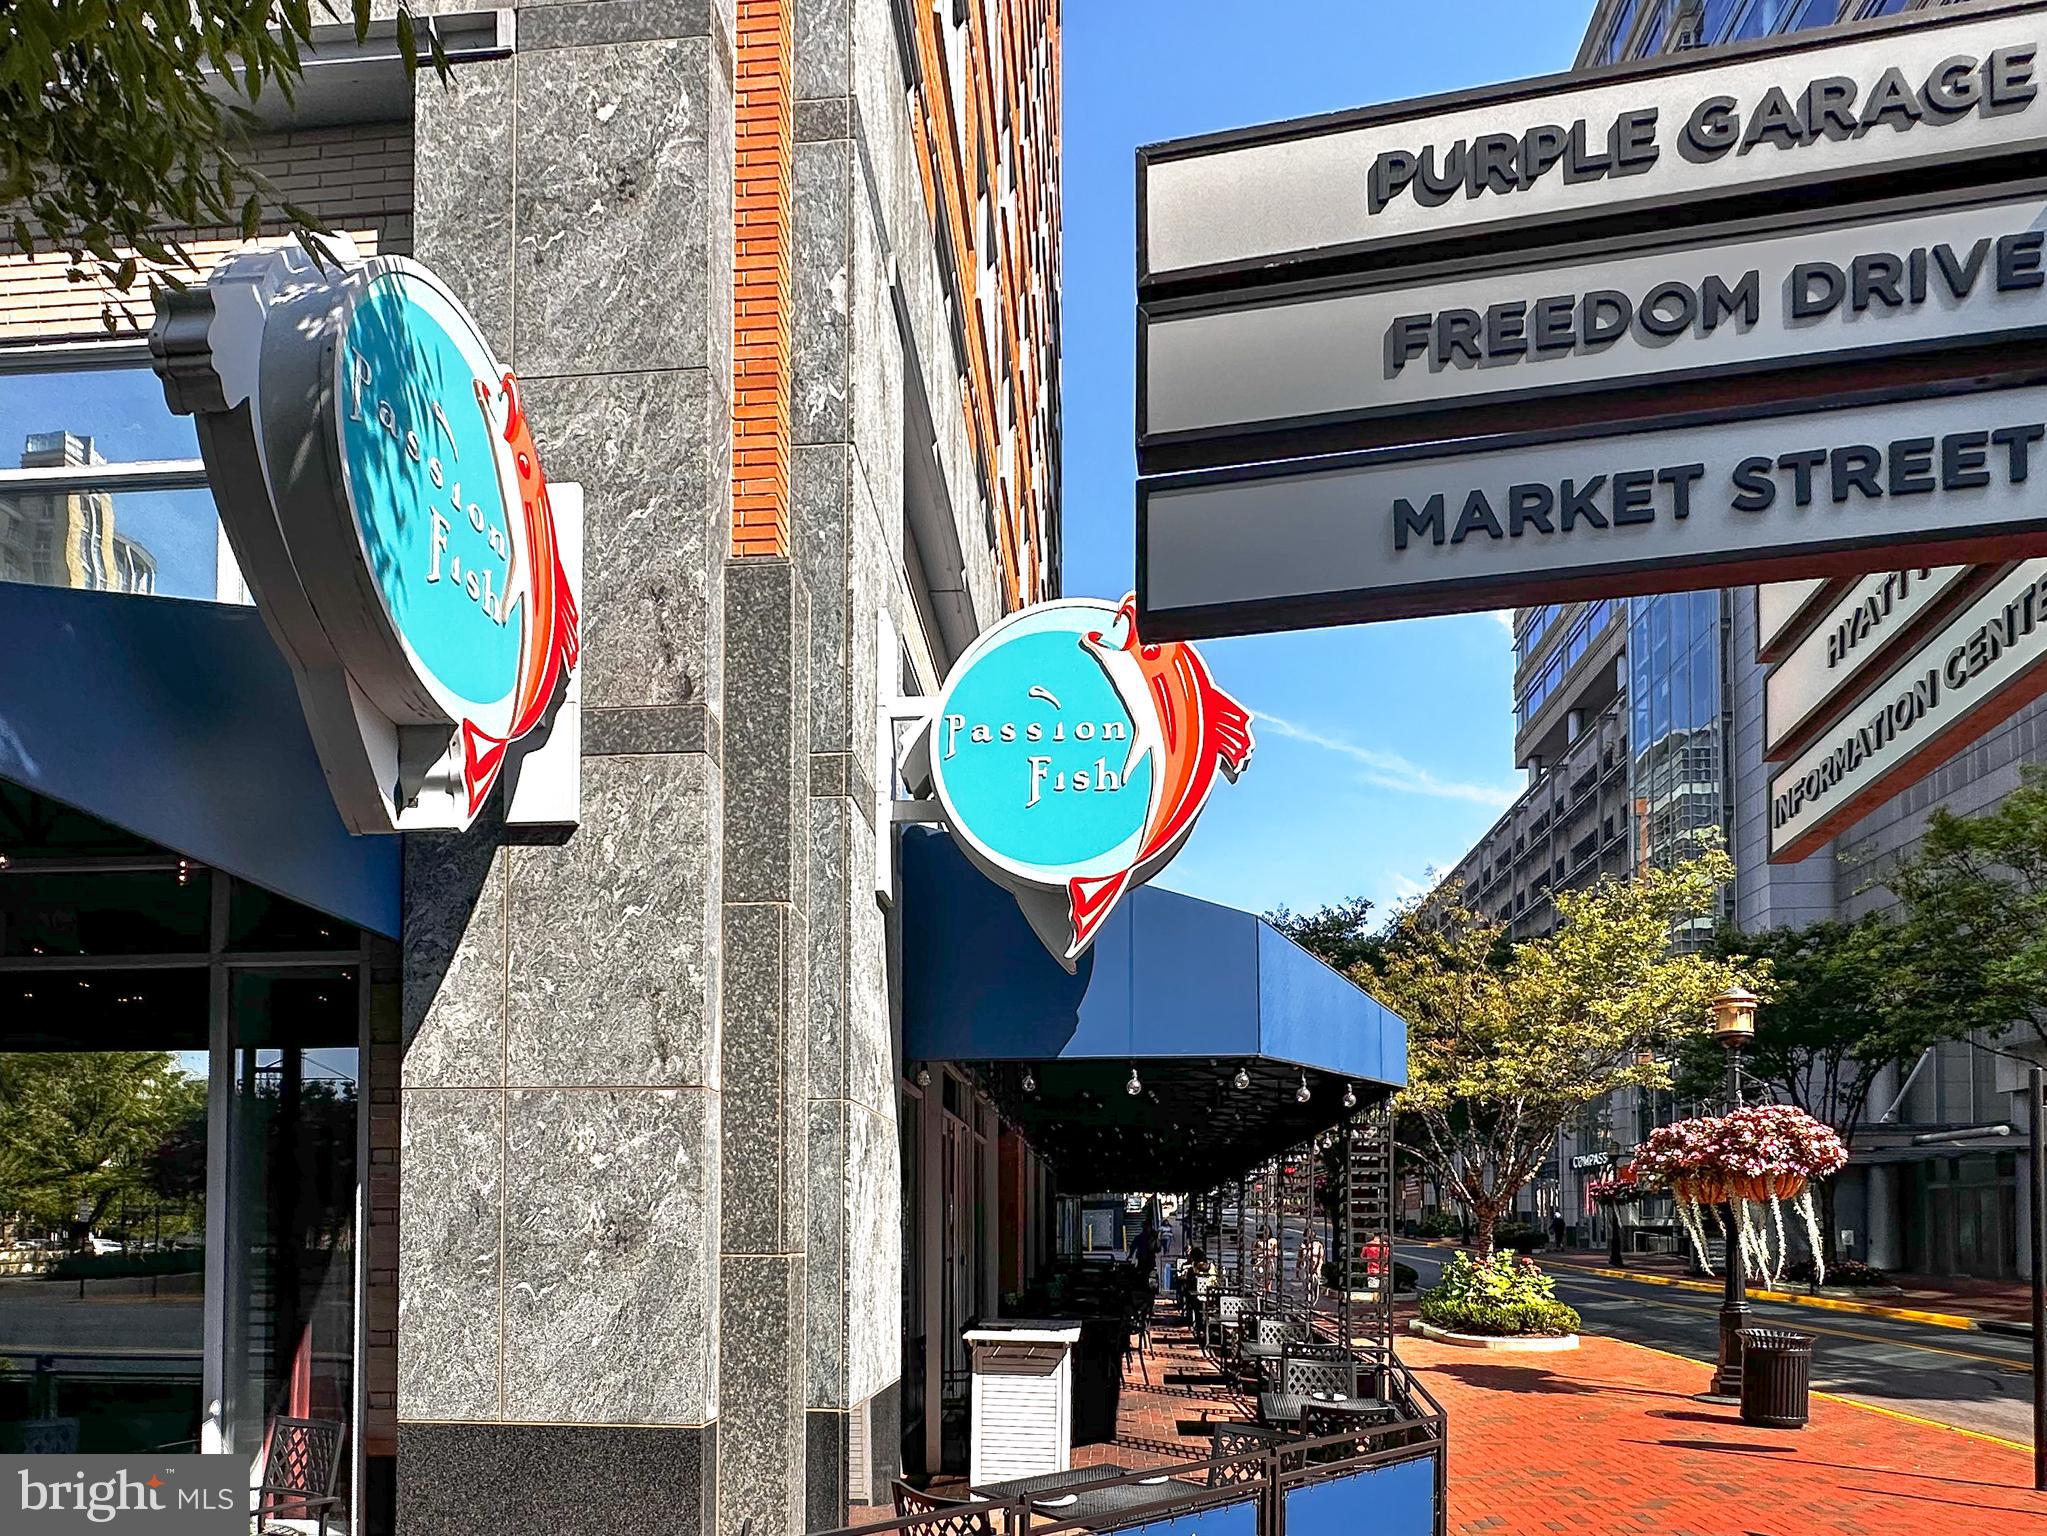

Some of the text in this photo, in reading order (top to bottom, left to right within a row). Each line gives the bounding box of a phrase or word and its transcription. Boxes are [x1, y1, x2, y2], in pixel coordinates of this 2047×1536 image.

[1372, 42, 2037, 208] PURPLE GARAGE
[1389, 231, 2044, 370] FREEDOM DRIVE
[350, 347, 506, 561] Passion
[1393, 423, 2045, 551] MARKET STREET
[426, 506, 502, 626] Fish
[945, 714, 1126, 760] Passion
[1025, 756, 1119, 809] Fish
[1773, 670, 1939, 828] INFORMATION
[1573, 1152, 1608, 1168] COMPASS
